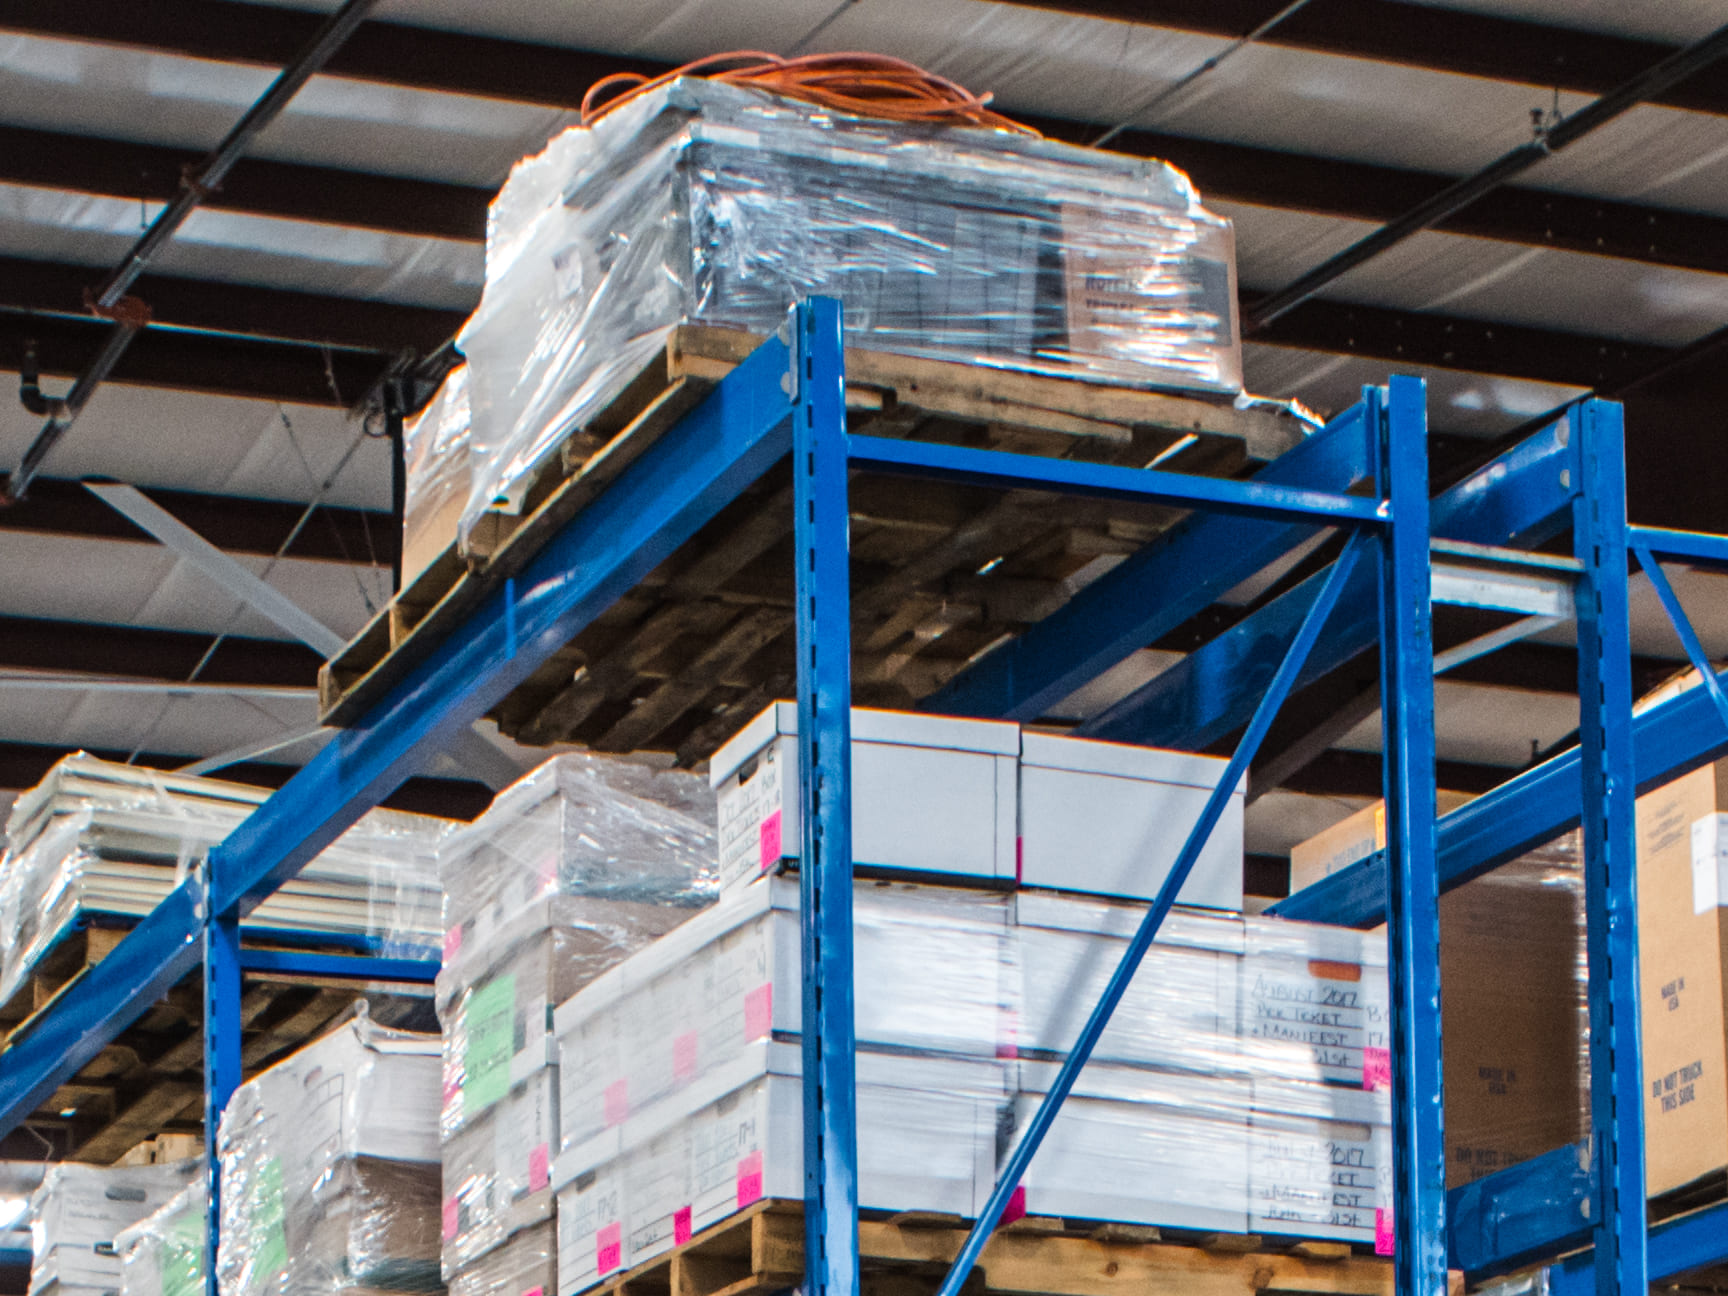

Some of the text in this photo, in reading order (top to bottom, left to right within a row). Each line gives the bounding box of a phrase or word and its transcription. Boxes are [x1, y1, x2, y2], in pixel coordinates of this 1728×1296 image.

[1321, 984, 1358, 1008] 2017
[1652, 1059, 1703, 1099] DO NOT TRUCK
[1660, 1083, 1696, 1114] THIS SIDE
